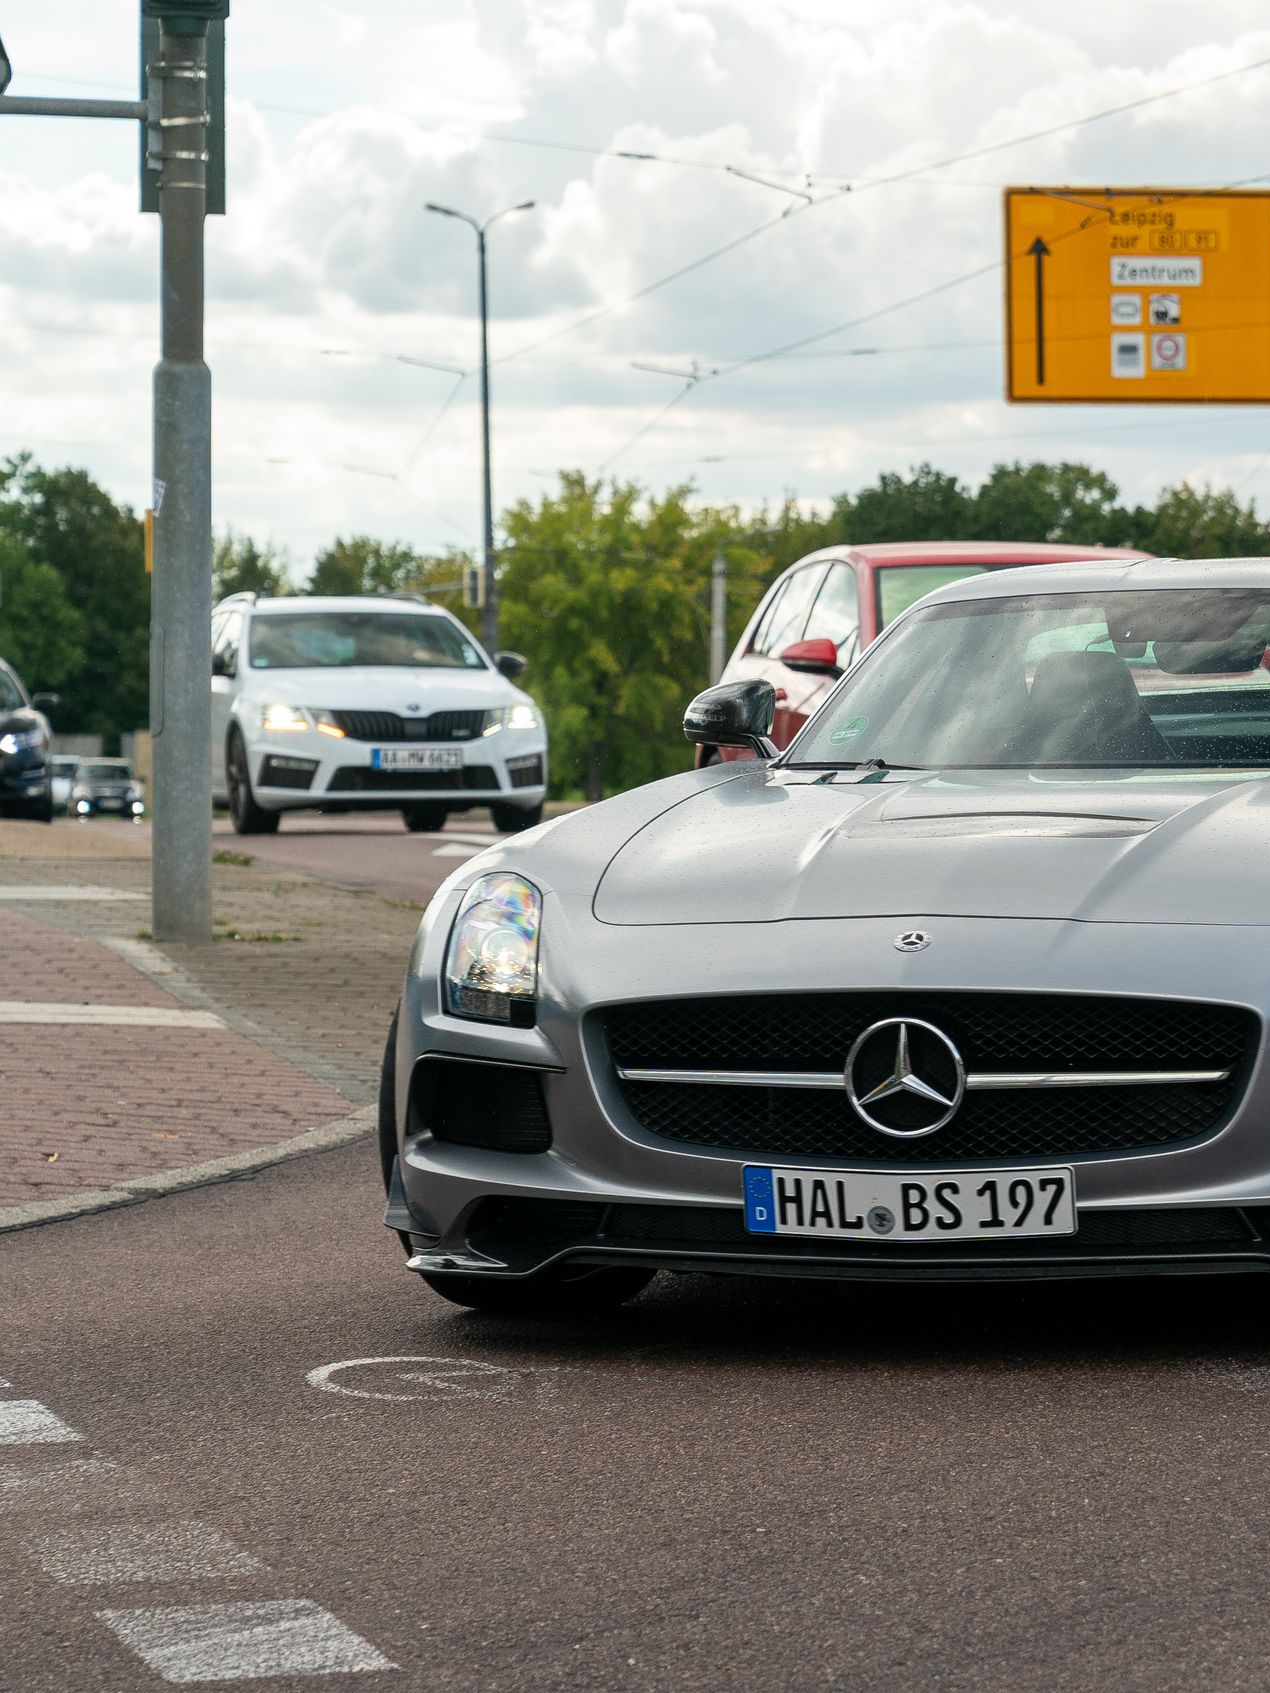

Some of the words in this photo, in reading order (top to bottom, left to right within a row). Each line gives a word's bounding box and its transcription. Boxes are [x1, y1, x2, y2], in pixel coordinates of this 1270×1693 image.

[1108, 208, 1175, 230] Leipzig
[1109, 235, 1139, 249] zur
[1117, 262, 1197, 281] Zentrum
[776, 1176, 865, 1230] HAL
[900, 1180, 964, 1231] BS
[976, 1176, 1066, 1228] 197
[755, 1206, 768, 1221] D
